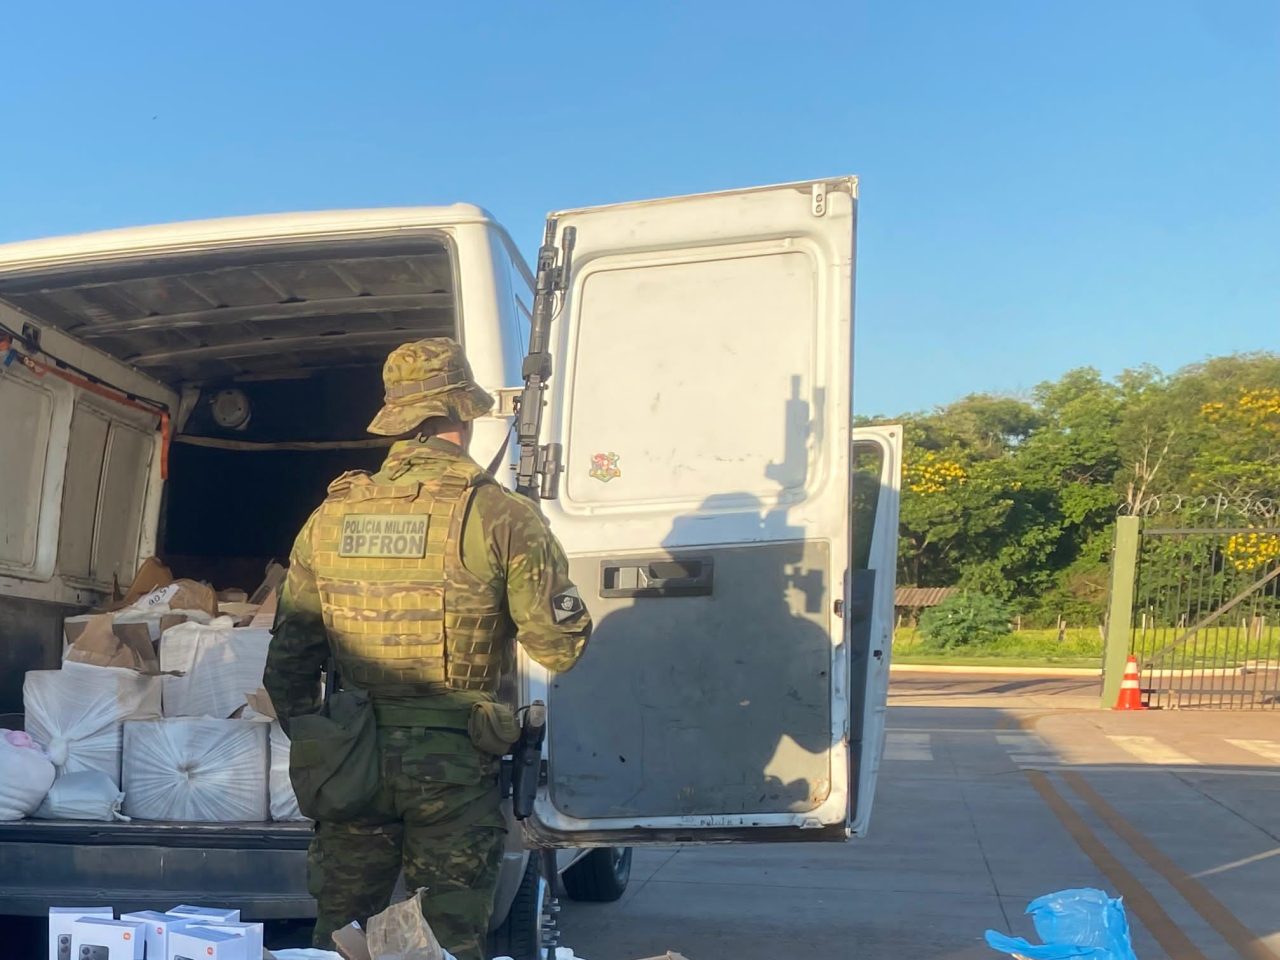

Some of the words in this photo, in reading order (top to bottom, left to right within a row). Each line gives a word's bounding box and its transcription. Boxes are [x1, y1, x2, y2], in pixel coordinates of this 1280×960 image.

[344, 517, 382, 534] POLÍCIA
[384, 520, 425, 534] MILITAR
[341, 535, 424, 555] BPFRON
